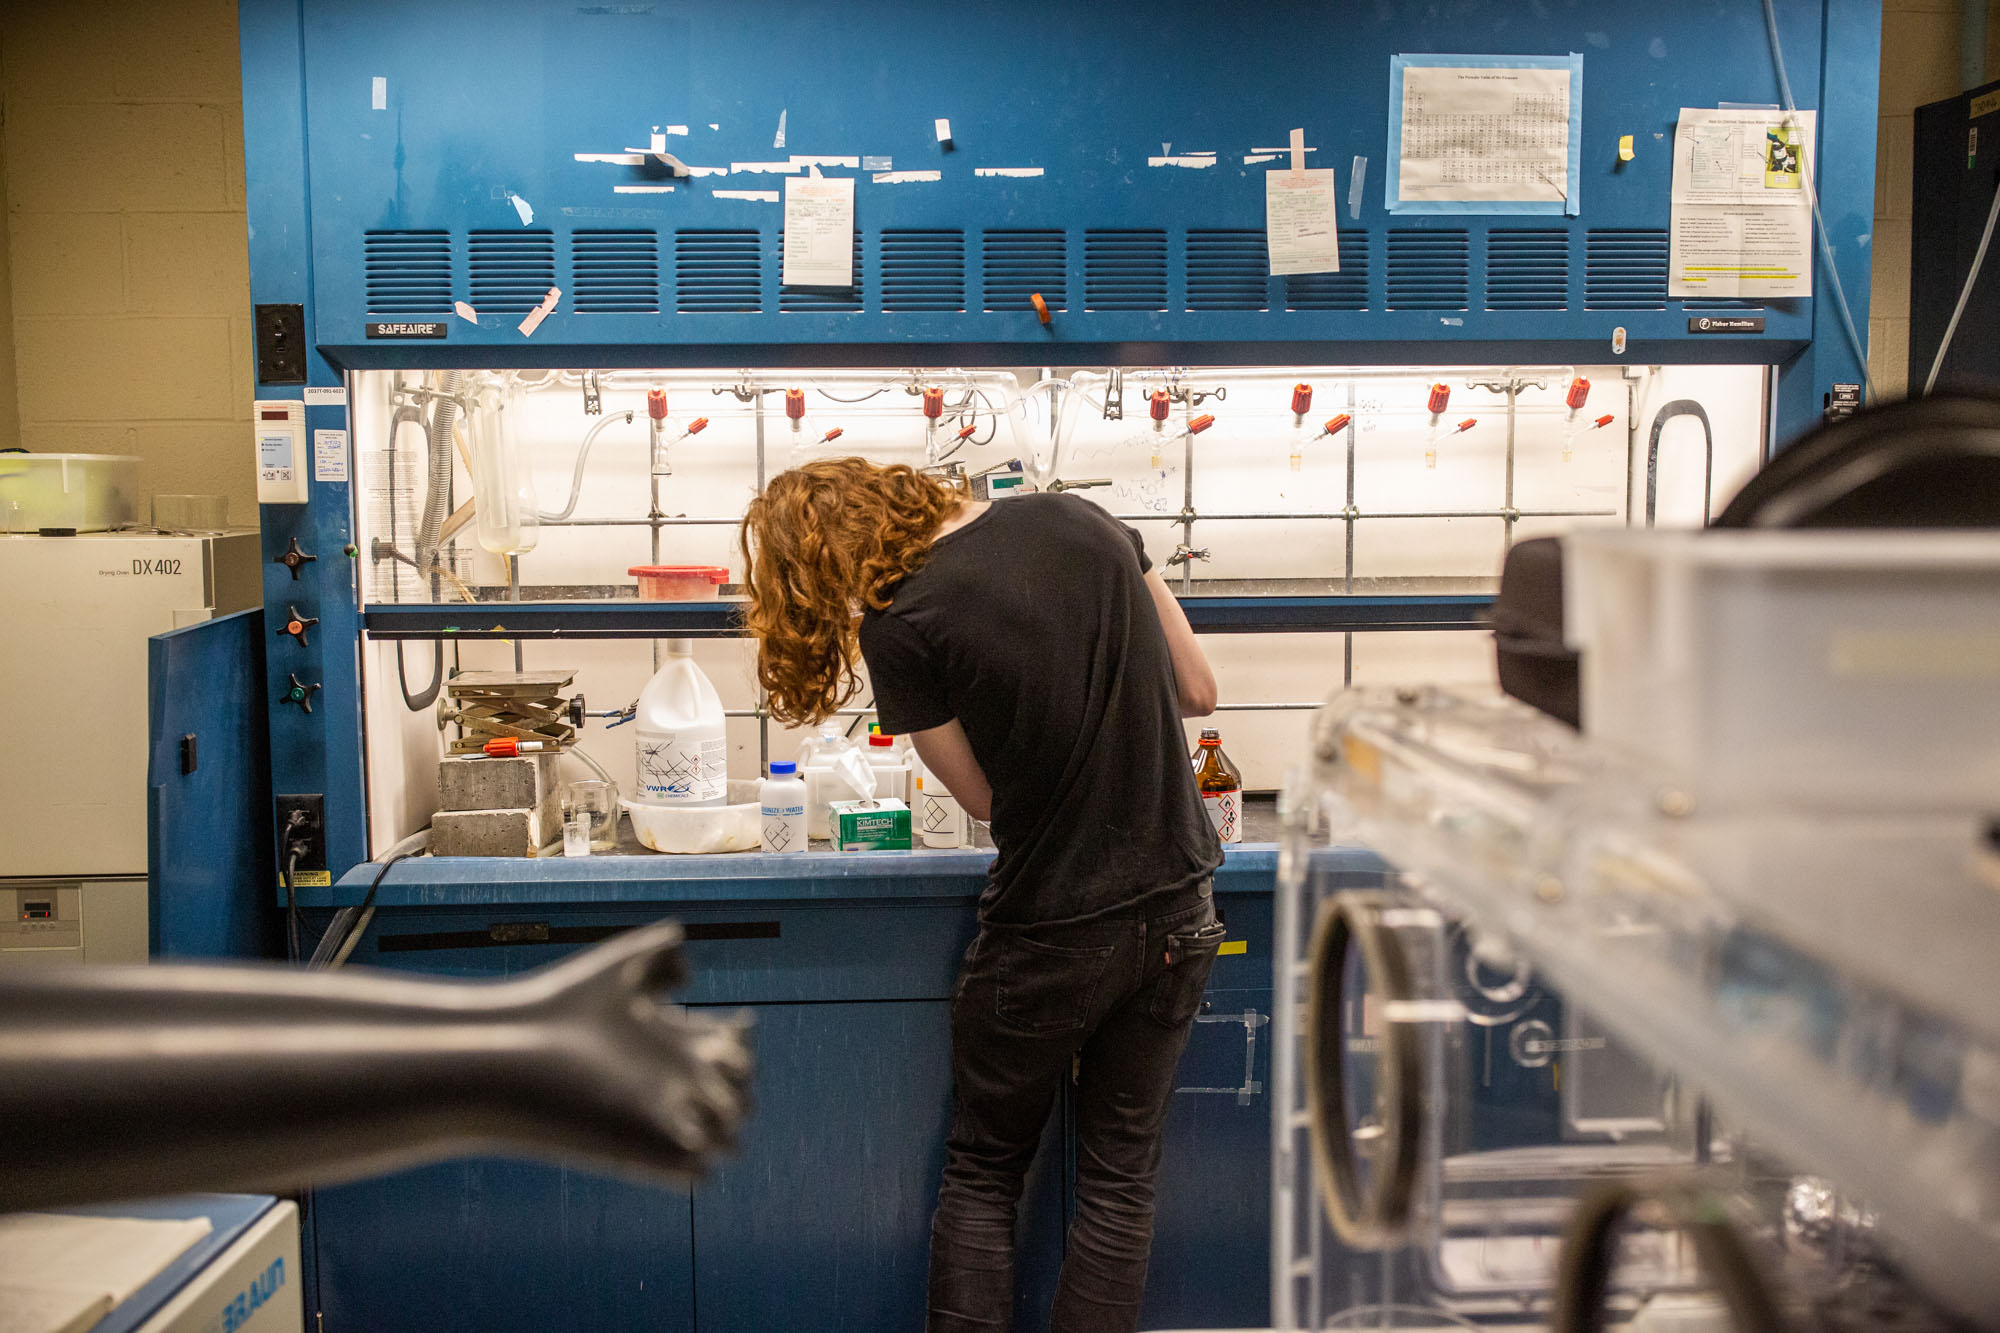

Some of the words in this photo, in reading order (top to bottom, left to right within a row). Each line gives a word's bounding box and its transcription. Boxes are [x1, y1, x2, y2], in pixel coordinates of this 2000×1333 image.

[132, 559, 153, 575] DX
[154, 559, 182, 575] 402
[646, 784, 667, 792] VWR
[785, 805, 803, 813] WATER
[857, 818, 893, 828] KIMTECH
